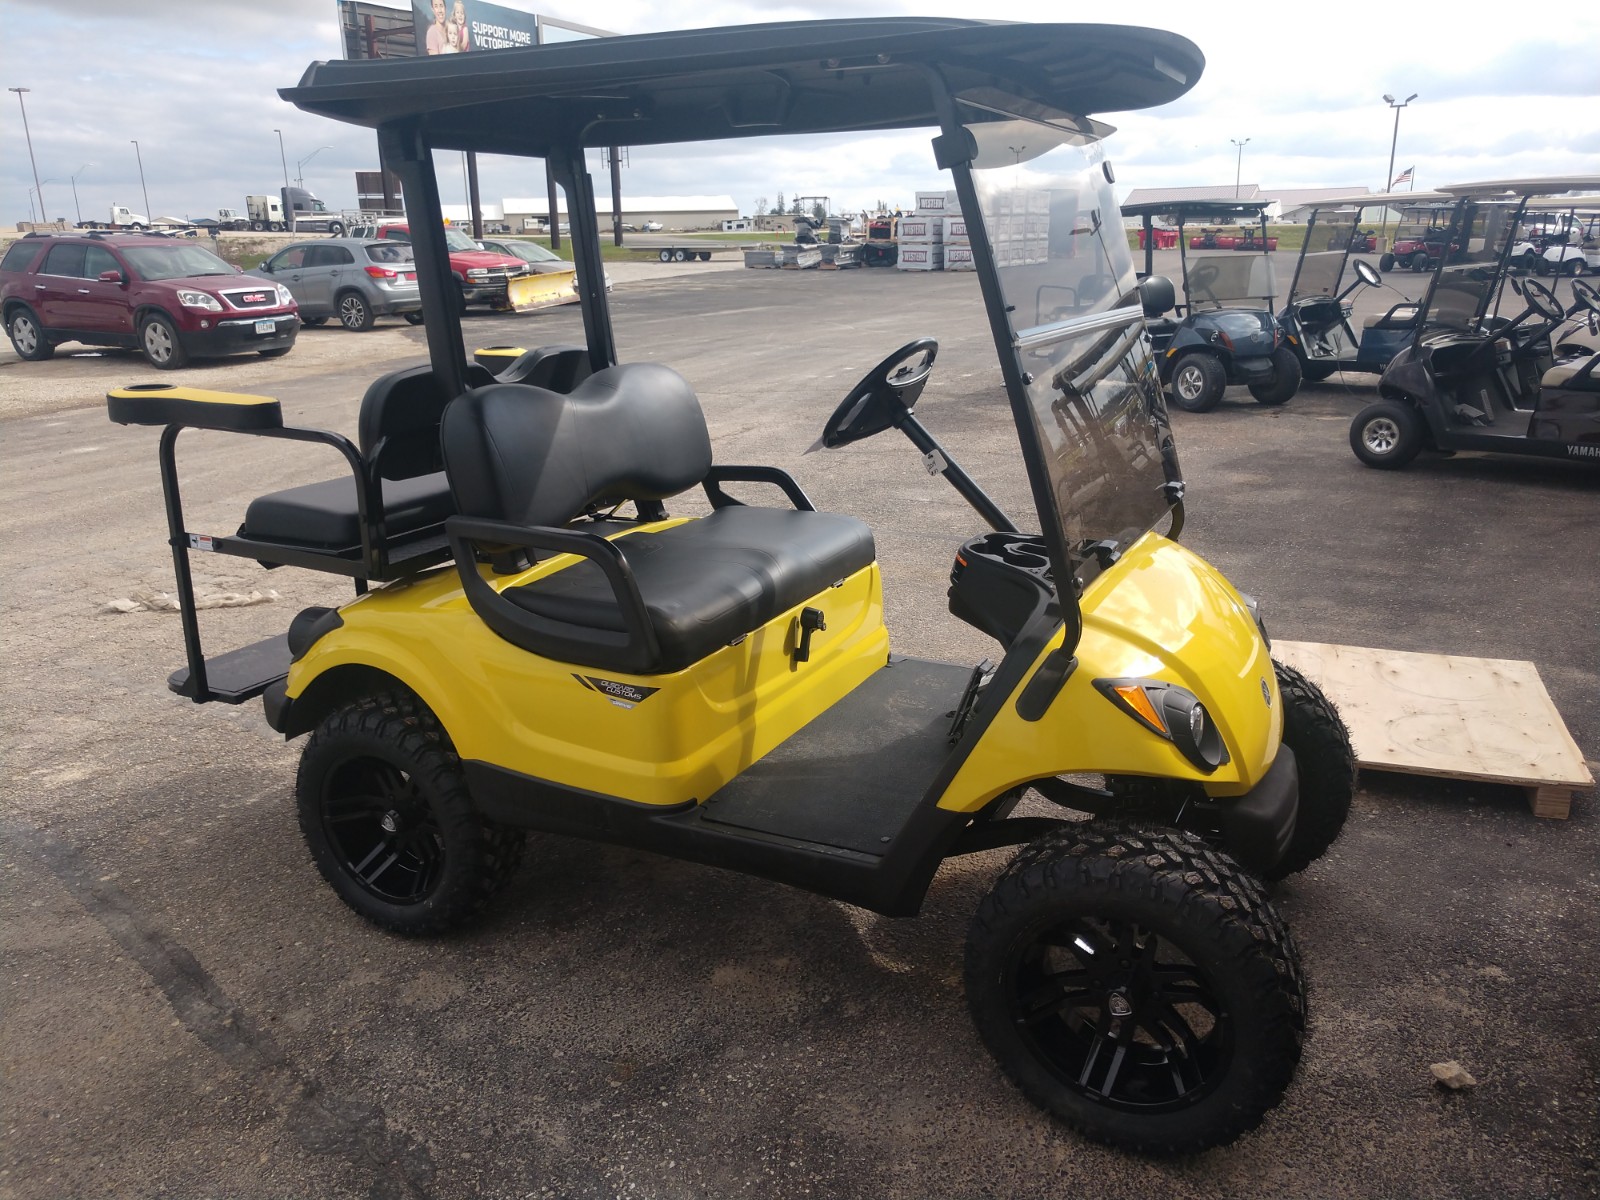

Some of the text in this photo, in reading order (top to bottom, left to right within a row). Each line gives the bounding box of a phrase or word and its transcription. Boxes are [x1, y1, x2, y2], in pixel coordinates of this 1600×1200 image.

[472, 21, 531, 44] SUPPORT MORE
[243, 294, 266, 303] GMC
[606, 686, 642, 700] CUSTOMS
